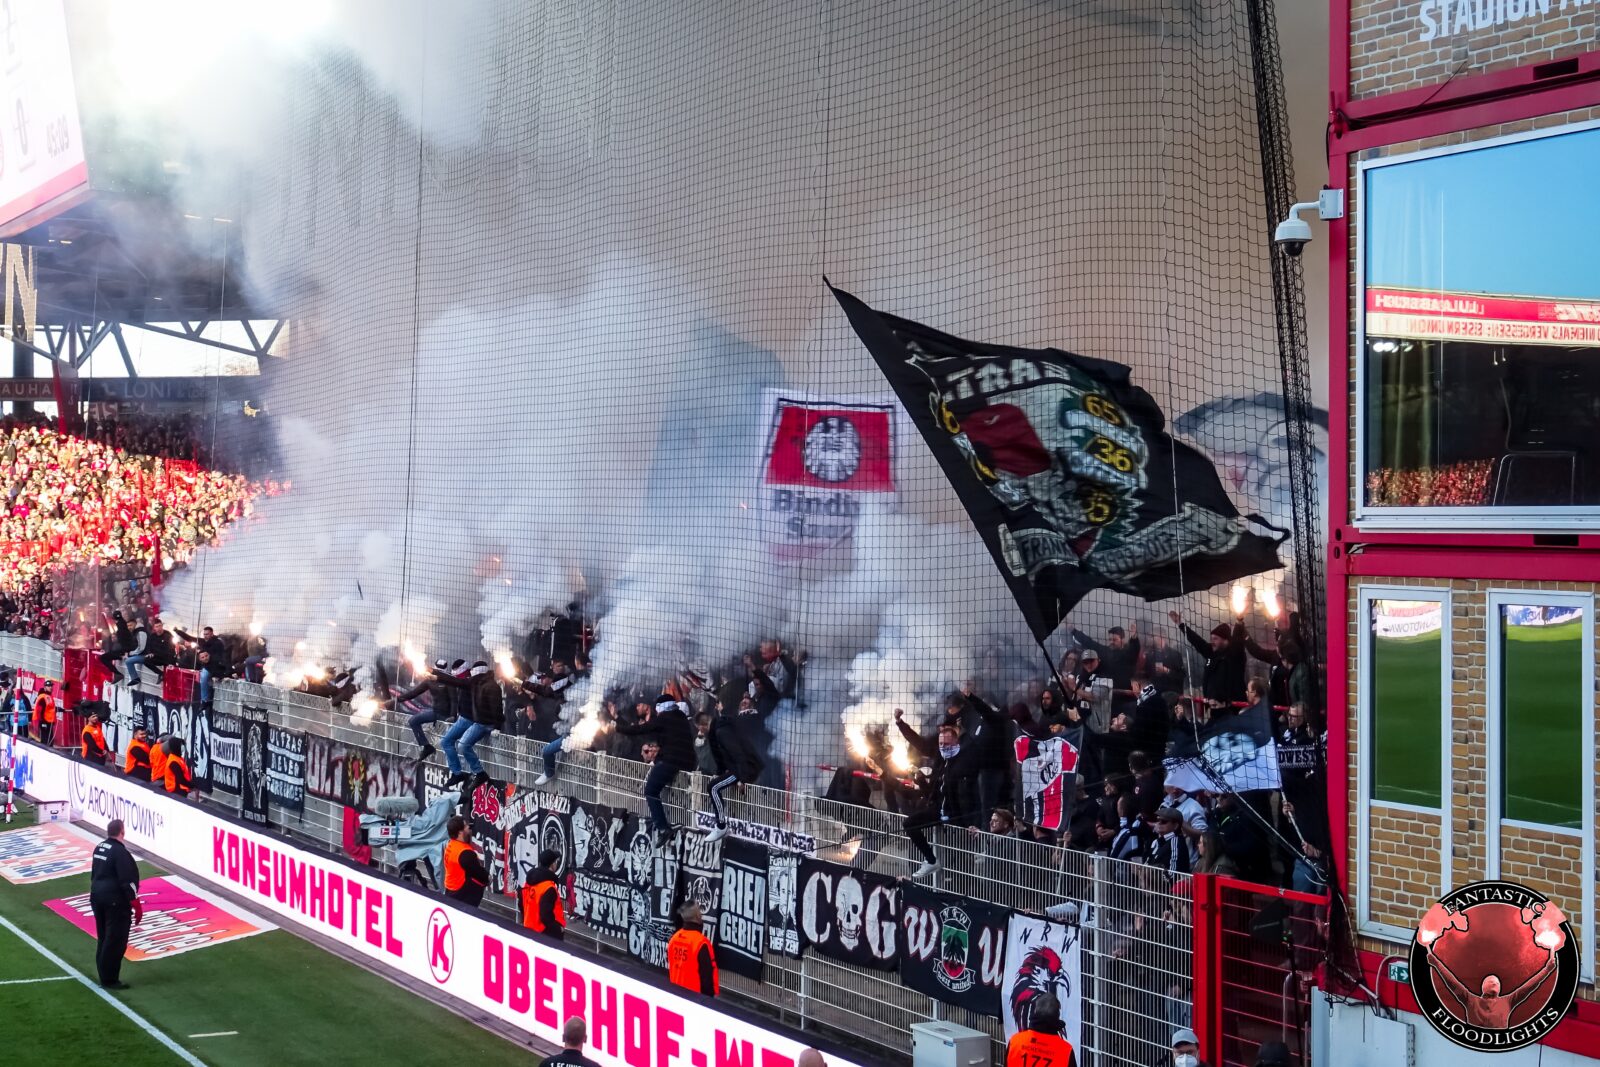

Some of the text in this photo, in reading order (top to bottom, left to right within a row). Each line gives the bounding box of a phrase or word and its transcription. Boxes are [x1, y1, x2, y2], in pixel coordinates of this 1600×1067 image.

[87, 785, 156, 840] AROUNDTOWN
[212, 825, 403, 959] KONSUMHOTEL
[721, 864, 766, 924] RIED
[720, 909, 765, 955] GEBIET
